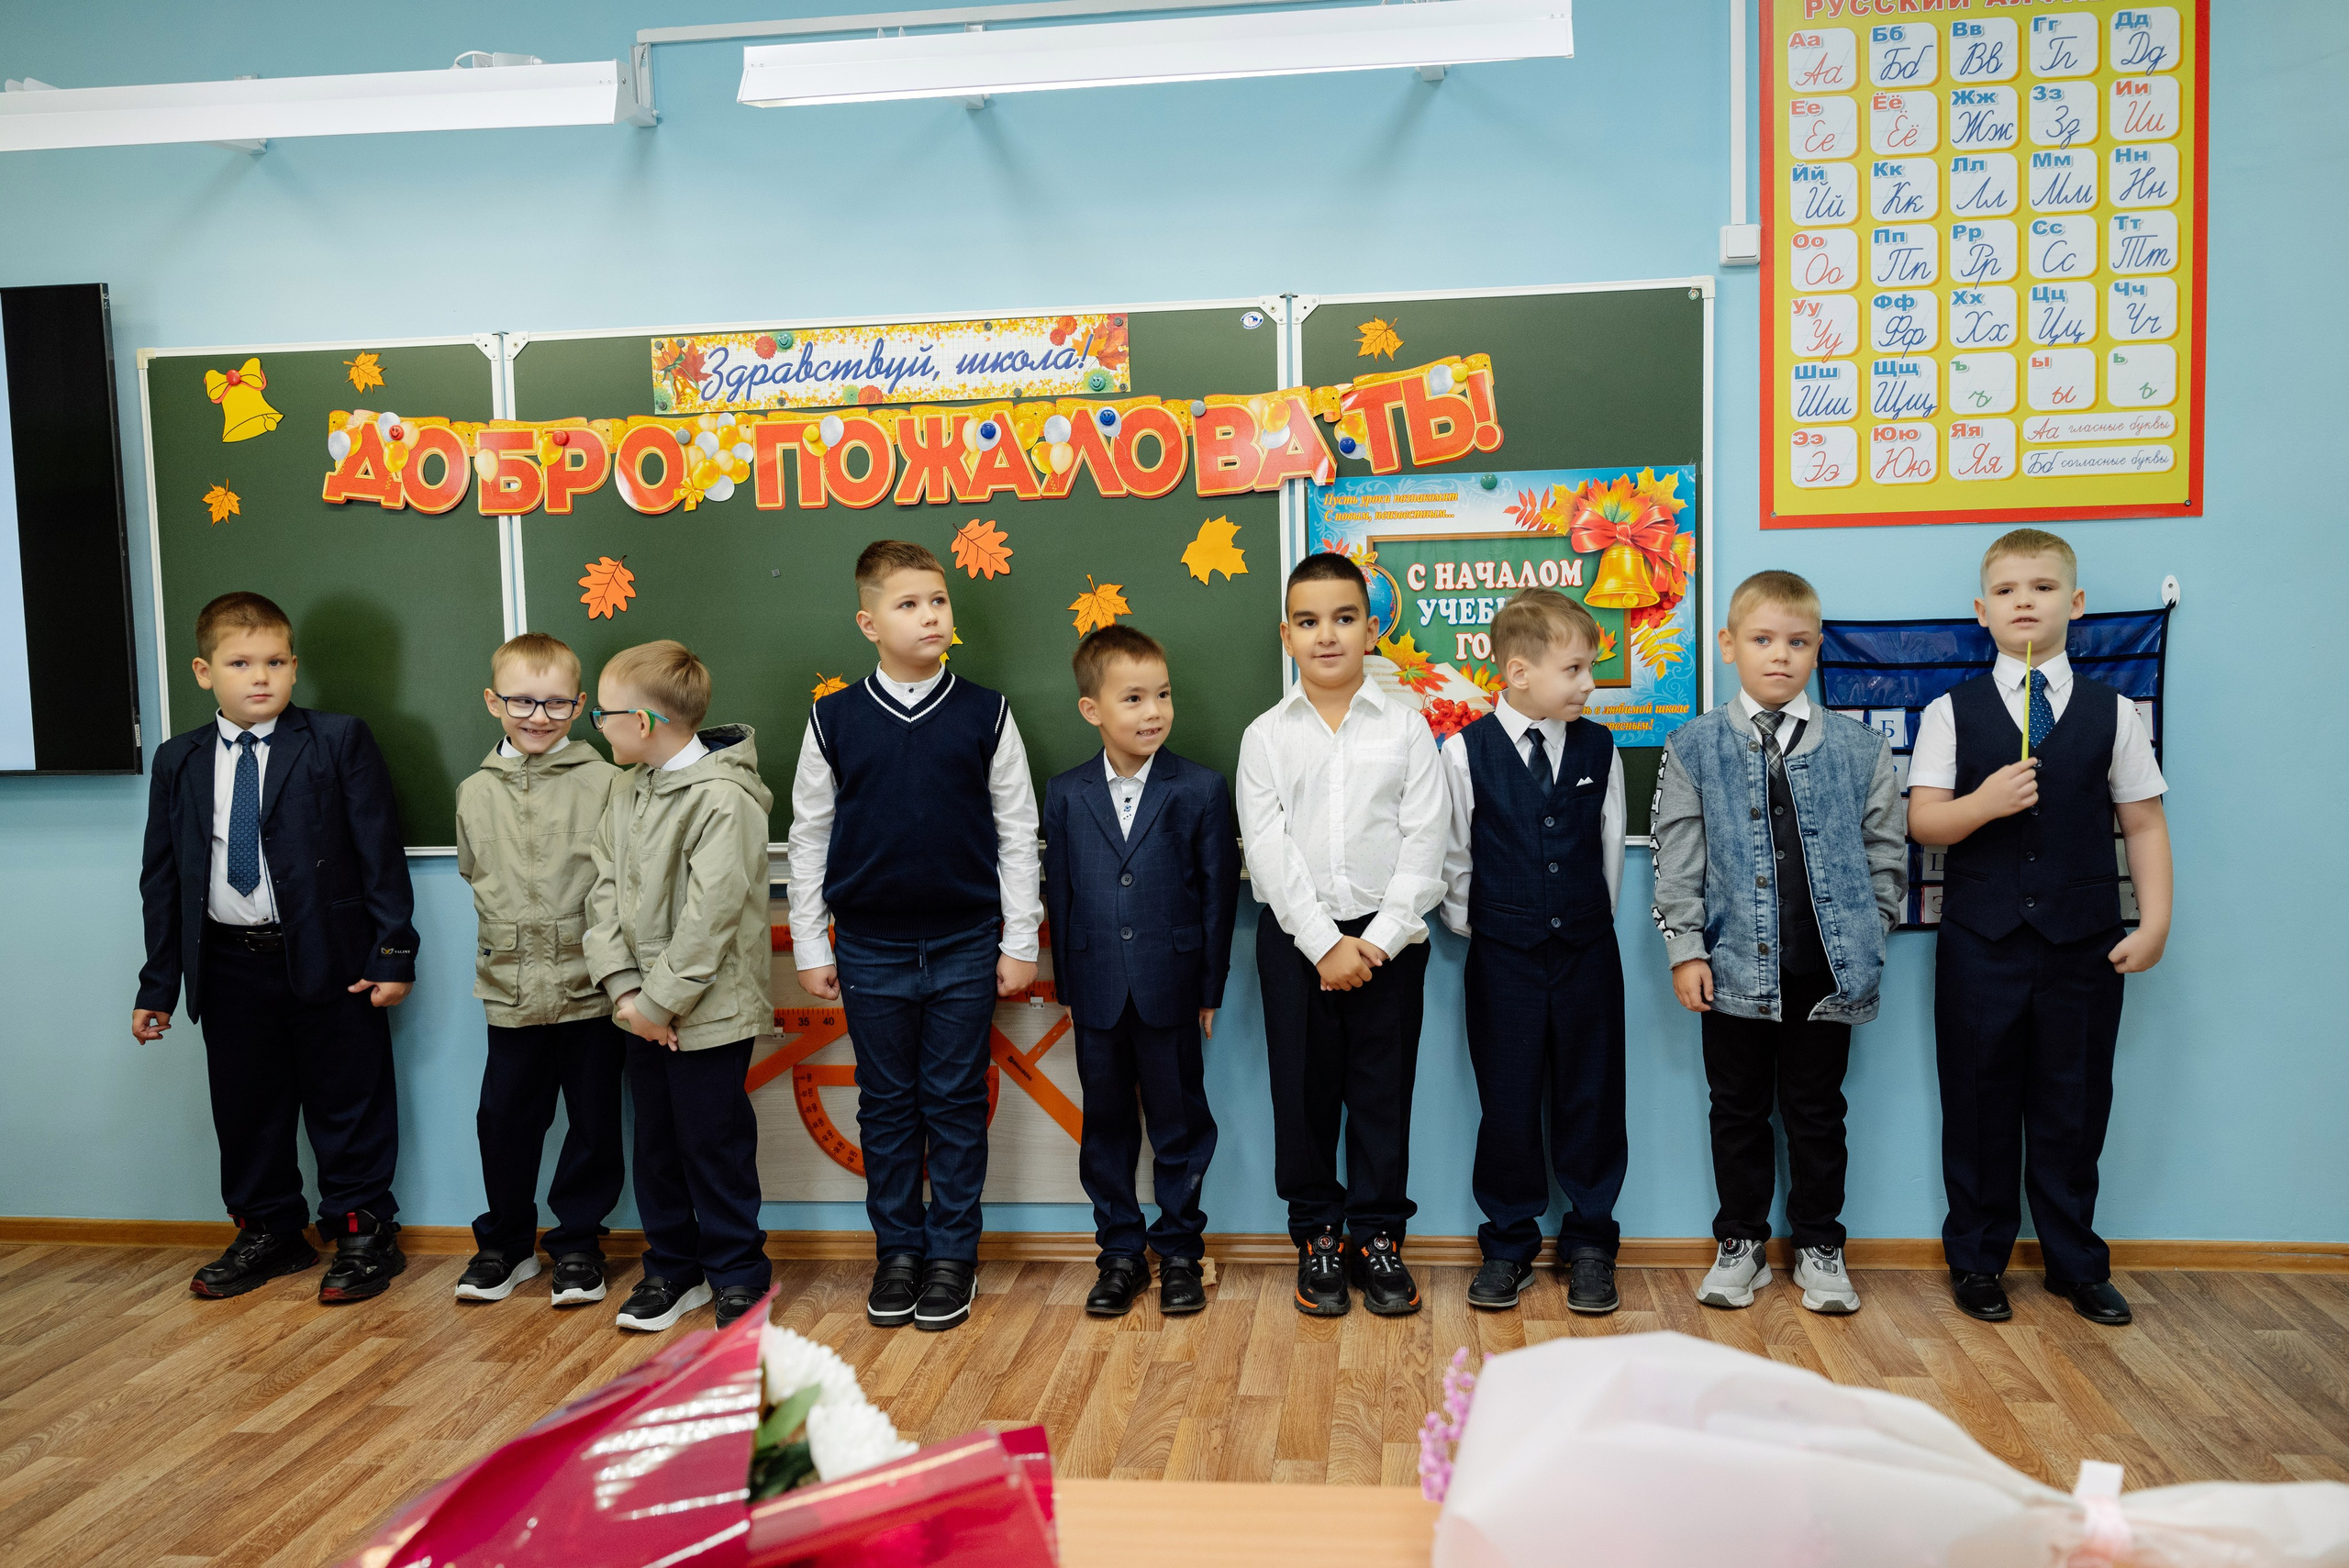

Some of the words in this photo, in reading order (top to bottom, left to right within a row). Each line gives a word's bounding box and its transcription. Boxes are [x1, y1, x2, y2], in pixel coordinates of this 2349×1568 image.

[1789, 32, 1820, 48] Аа
[1872, 25, 1904, 43] Бб
[1952, 21, 1983, 38] Вв
[2032, 17, 2059, 33] Гг
[2114, 11, 2150, 30] Дд
[1796, 52, 1842, 85] Аа
[1880, 44, 1932, 81] Бб
[1959, 41, 2002, 75] Вв
[2041, 37, 2076, 71] Гг
[2121, 30, 2167, 76] Дд
[1790, 100, 1820, 116] Ее
[1873, 93, 1903, 111] Ёё
[1952, 89, 1997, 106] Жж
[2032, 84, 2063, 101] Зз
[2115, 80, 2148, 96] Ии
[1805, 120, 1834, 152] Ее
[1887, 111, 1918, 147] Ёё
[1954, 110, 2013, 143] Жж
[2046, 105, 2080, 150] Зз
[2124, 101, 2165, 133] Ии
[1792, 164, 1825, 183] Йй
[1873, 161, 1903, 177] Кк
[1951, 156, 1986, 173] Лл
[2032, 152, 2071, 168] Мм
[2114, 148, 2148, 164] Нн
[1806, 182, 1844, 218] Йй
[1883, 182, 1924, 214] Кк
[1956, 176, 2008, 210] Лл
[2032, 172, 2093, 206] Мм
[2119, 167, 2167, 201] Нн
[1792, 233, 1825, 249] Оо
[1873, 228, 1906, 245] Пп
[1952, 224, 1983, 241] Рр
[2032, 219, 2063, 236] Сс
[2113, 216, 2142, 231] Тт
[1805, 253, 1843, 285] Оо
[1877, 247, 1931, 282] Пп
[1958, 243, 2001, 290] Рр
[2042, 239, 2076, 272] Сс
[2112, 235, 2171, 269] Тт
[1792, 299, 1821, 317] Уу
[1873, 294, 1916, 312] Фф
[1952, 290, 1983, 306] Хх
[2032, 285, 2066, 304] Цц
[2113, 282, 2145, 297] Чч
[1807, 318, 1842, 363] Уу
[1878, 315, 1928, 360] Фф
[1956, 311, 2009, 343] Хх
[2039, 306, 2085, 347] Цц
[2127, 302, 2161, 334] Чч
[700, 337, 941, 402] Здравствуй,
[955, 333, 1094, 375] школа!
[1794, 364, 1839, 381] Шш
[1873, 360, 1920, 378] Щщ
[1798, 385, 1851, 417] Шш
[1875, 381, 1937, 420] Щщ
[322, 419, 691, 516] ДОБРО
[753, 368, 1505, 514] ПОЖАЛОВАТЬ!
[1792, 430, 1824, 446] Ээ
[1873, 426, 1919, 441] Юю
[1951, 422, 1981, 438] Яя
[2027, 417, 2060, 440] Аа
[2068, 422, 2125, 434] гласные
[2130, 416, 2170, 436] буквы
[1805, 451, 1839, 483] Ээ
[1876, 447, 1932, 479] Юю
[1958, 443, 2002, 475] Яя
[2028, 451, 2064, 473] Бб
[2061, 456, 2126, 468] согласные
[2131, 450, 2169, 470] буквы
[1323, 494, 1358, 507] Пусть
[1360, 494, 1391, 507] уроки
[1393, 492, 1458, 504] познакомят
[1324, 510, 1333, 521] С
[1335, 511, 1372, 522] новым,
[1375, 509, 1454, 520] неизвестным...
[1407, 562, 1426, 591] С
[1434, 558, 1584, 591] НАЧАЛОМ
[1455, 632, 1495, 663] ГО
[1602, 702, 1653, 715] любимой
[1655, 704, 1689, 714] школе
[1880, 719, 1895, 739] Б
[797, 1018, 809, 1026] 35
[823, 1017, 835, 1026] 40
